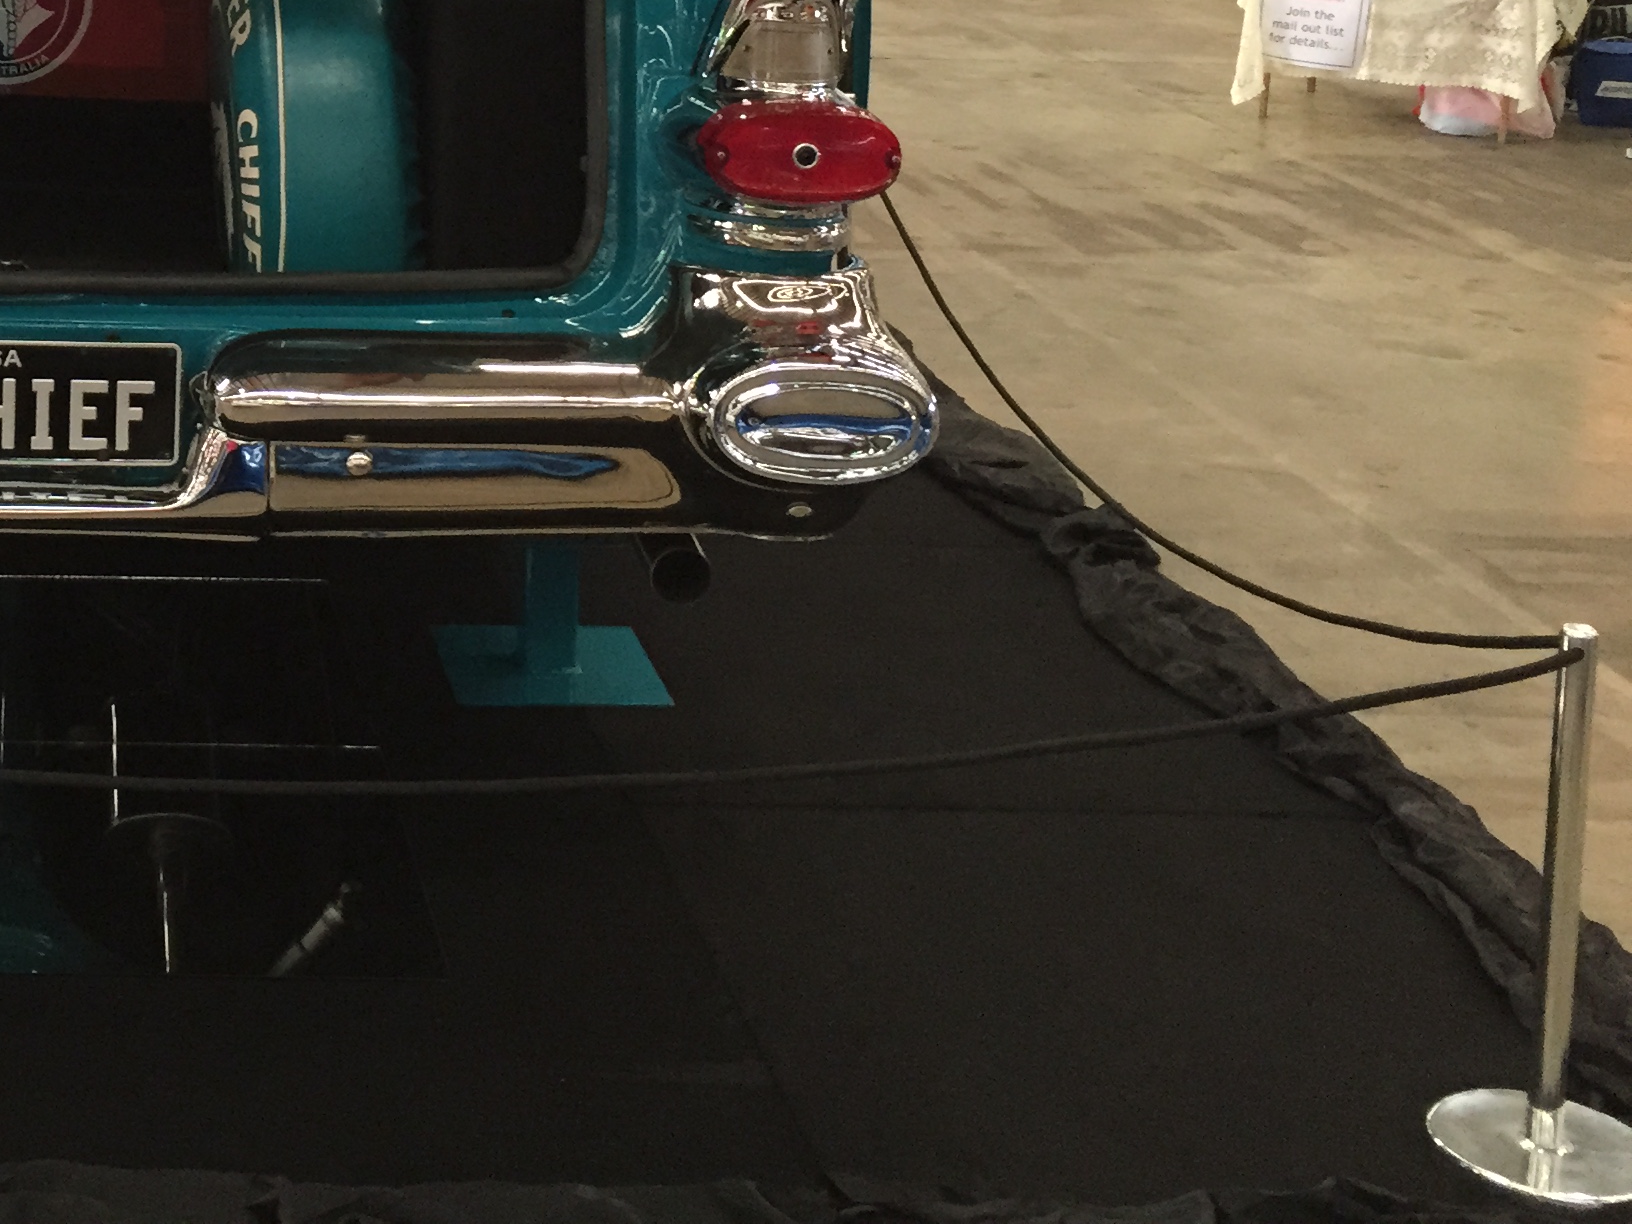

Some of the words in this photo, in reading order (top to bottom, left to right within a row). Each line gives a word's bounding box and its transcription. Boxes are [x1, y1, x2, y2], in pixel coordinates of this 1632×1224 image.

[1286, 6, 1311, 18] Join
[1314, 9, 1336, 21] the
[1272, 20, 1298, 32] mail
[1301, 23, 1322, 33] out
[1325, 24, 1345, 37] list
[1269, 32, 1285, 43] for
